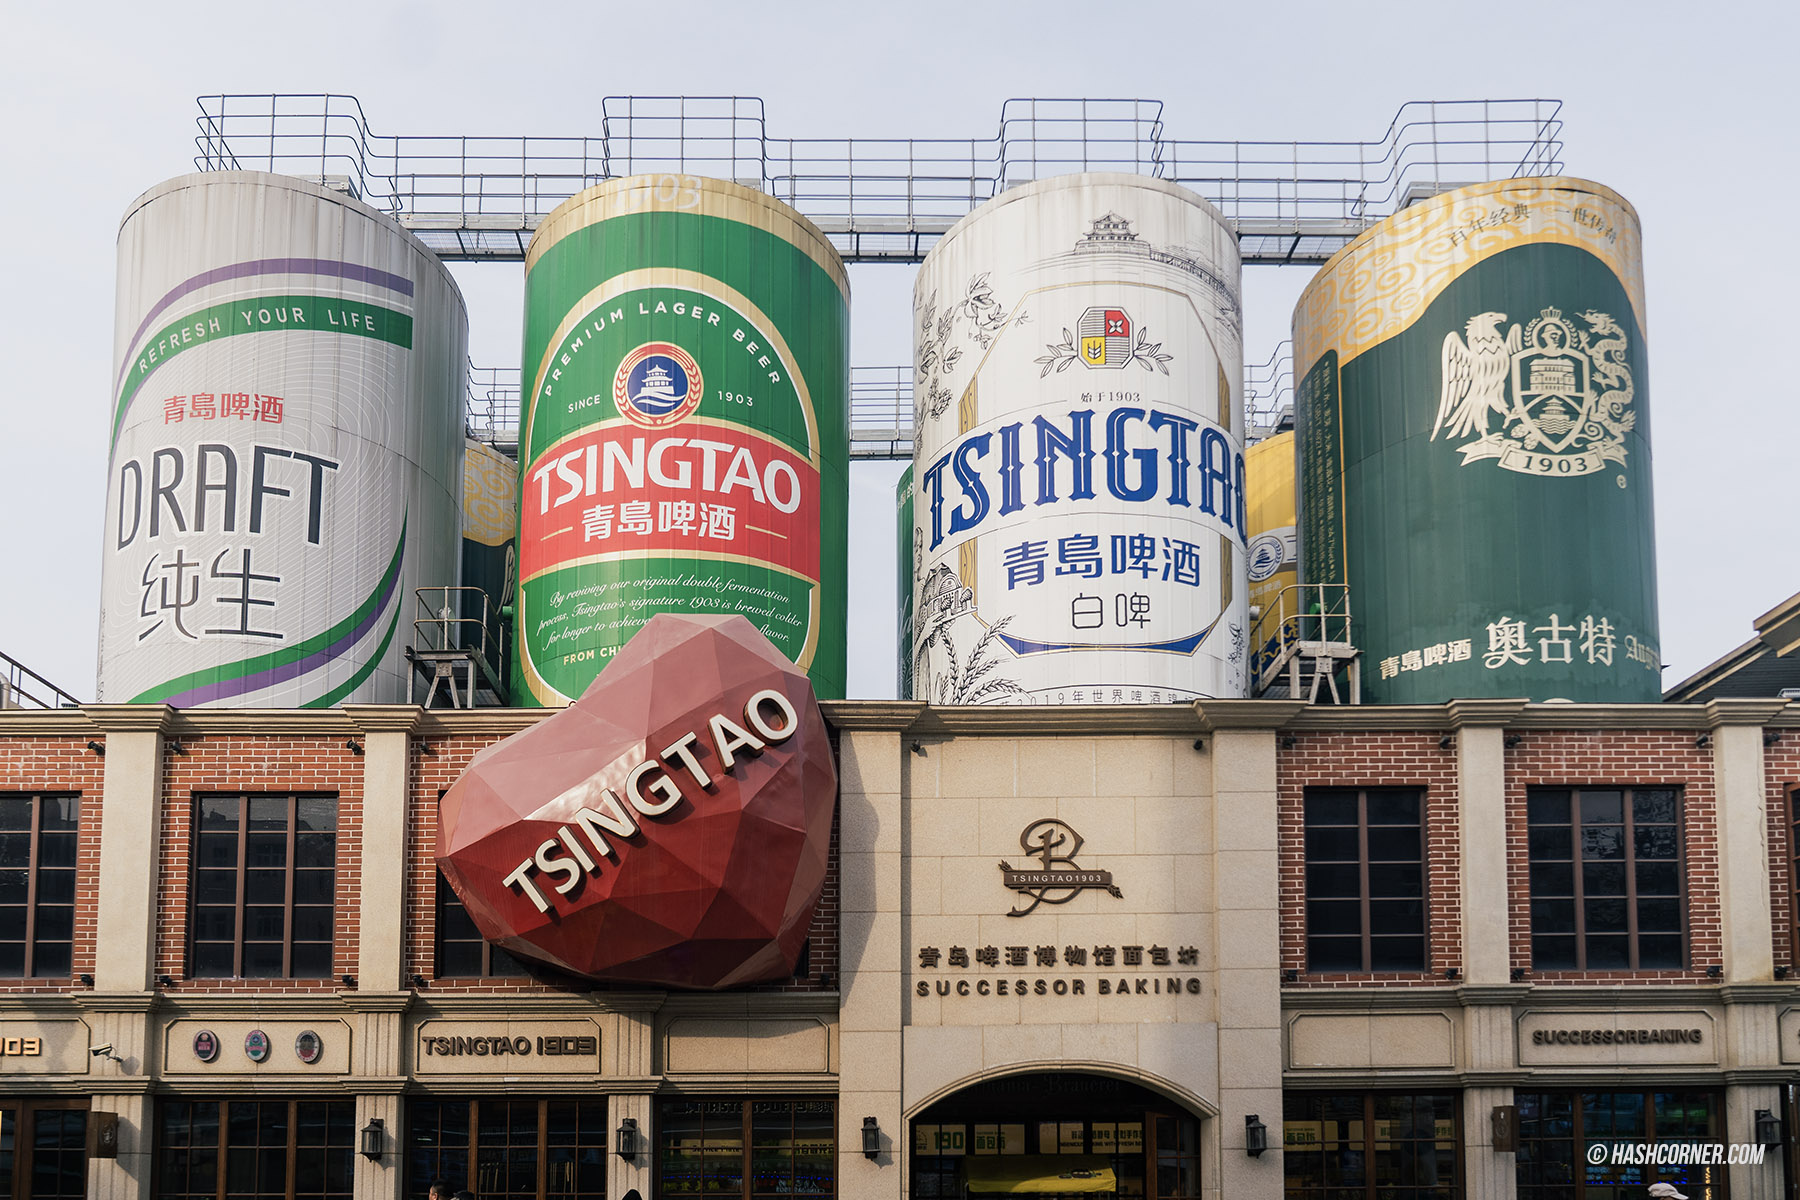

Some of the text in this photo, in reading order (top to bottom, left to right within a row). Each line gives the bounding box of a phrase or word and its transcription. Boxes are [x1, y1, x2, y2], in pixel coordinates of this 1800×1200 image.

[137, 307, 377, 374] REFRESH YOUR LIFE
[545, 301, 781, 397] PREMIUM LAGER BEER
[163, 392, 284, 425] 青島啤酒
[567, 394, 601, 413] SINCE
[717, 390, 754, 407] 1903
[1080, 391, 1141, 404] 始于1903
[532, 437, 801, 516] TSINGTAO
[1521, 456, 1589, 473] 1903
[117, 443, 340, 551] DRAFT
[581, 500, 736, 543] 青島啤酒
[1002, 532, 1201, 591] 青島啤酒
[138, 547, 284, 642] 纯生
[549, 573, 790, 608] By reviving our original double fermentation
[628, 596, 686, 611] signature
[688, 596, 721, 609] 1903
[721, 600, 732, 609] is
[734, 599, 776, 618] brewed
[774, 612, 803, 628] colder
[1071, 591, 1151, 630] 白啤
[542, 631, 562, 651] for
[561, 626, 593, 641] longer
[594, 620, 607, 632] to
[563, 649, 595, 666] FROM
[1379, 638, 1472, 680] 青島啤酒
[502, 689, 798, 915] TSINGTAO
[1012, 874, 1102, 883] TSINGTAO1903
[919, 944, 1199, 968] 青岛啤酒博物馆面包坊
[916, 976, 1202, 997] SUCCESSOR BAKING
[0, 1037, 41, 1056] 03
[422, 1036, 597, 1056] TSINGTAO 1903
[1532, 1028, 1703, 1045] SUCCESSORBAKING
